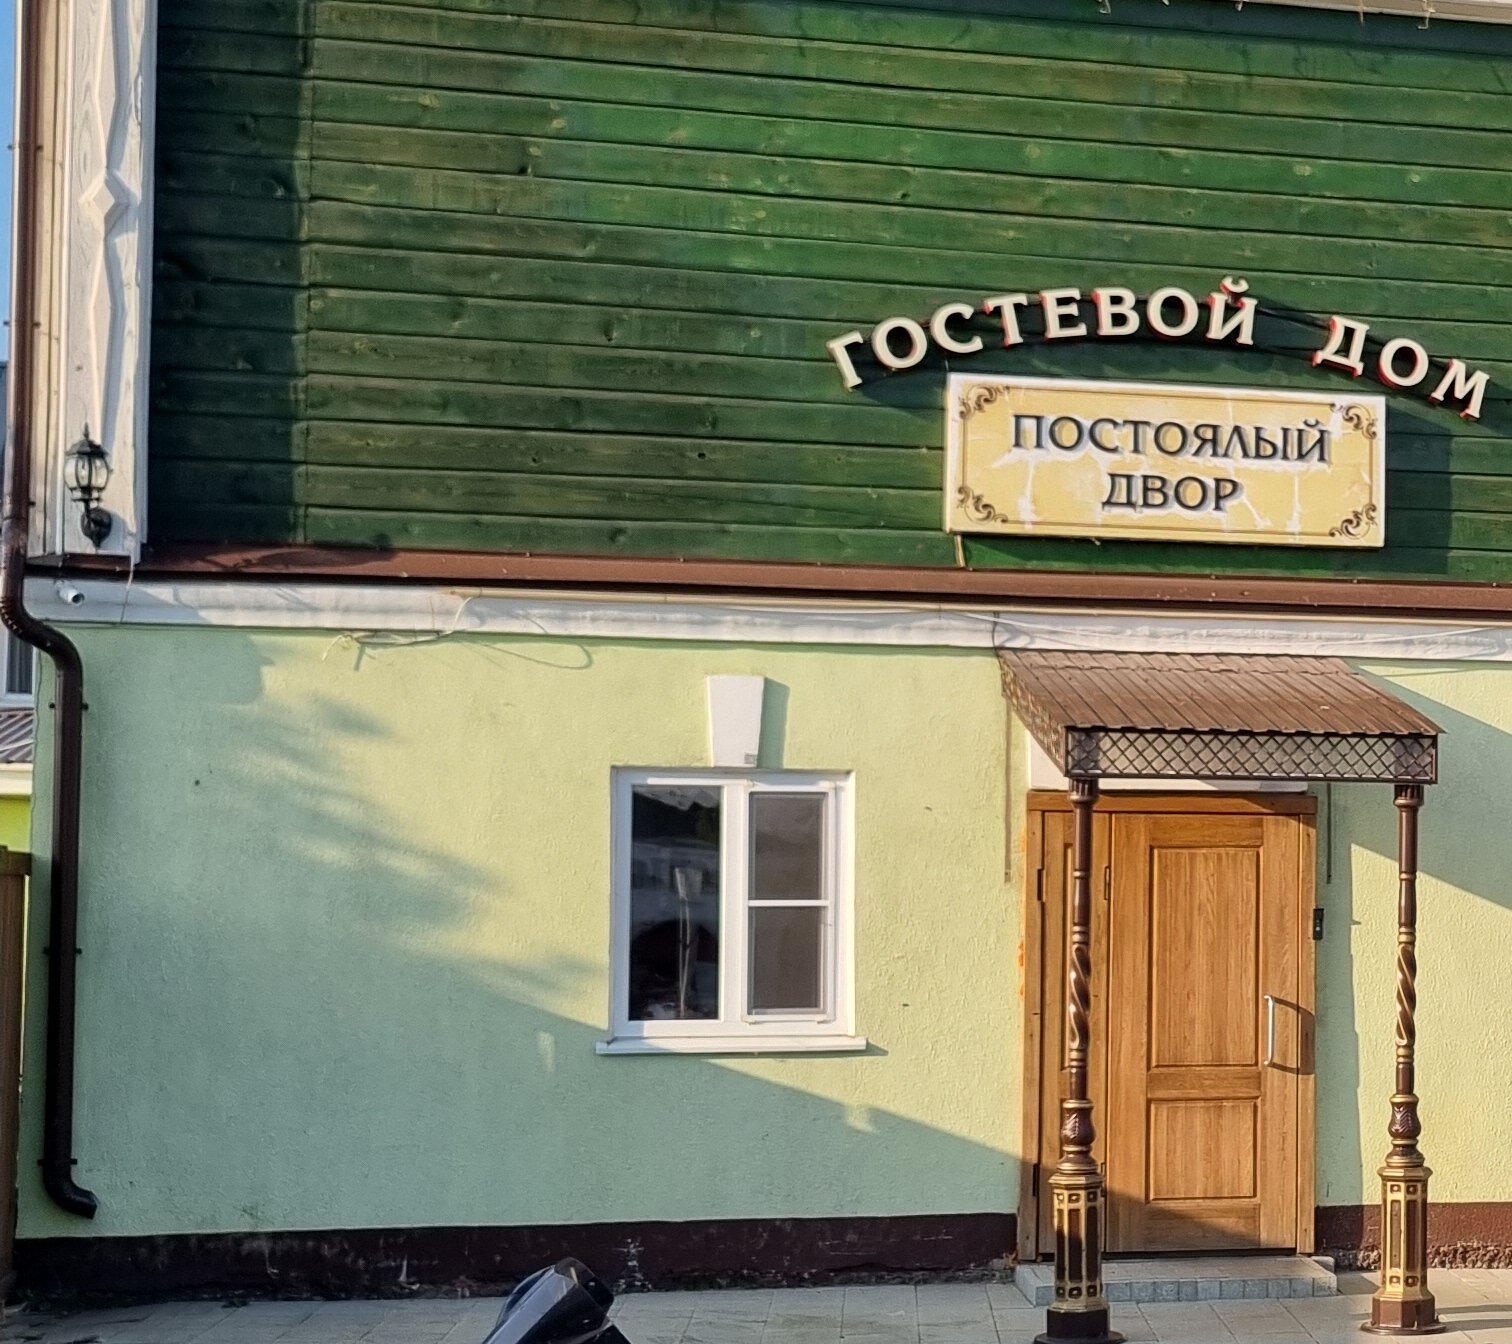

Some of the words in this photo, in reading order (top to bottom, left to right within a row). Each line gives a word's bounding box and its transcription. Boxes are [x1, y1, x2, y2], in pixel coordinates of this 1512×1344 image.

[826, 276, 1259, 392] ГОСТЕВОЙ
[1311, 315, 1491, 421] ДОМ
[1010, 414, 1331, 464] ПОСТОЯЛЫЙ
[1101, 472, 1243, 512] ДВОР
